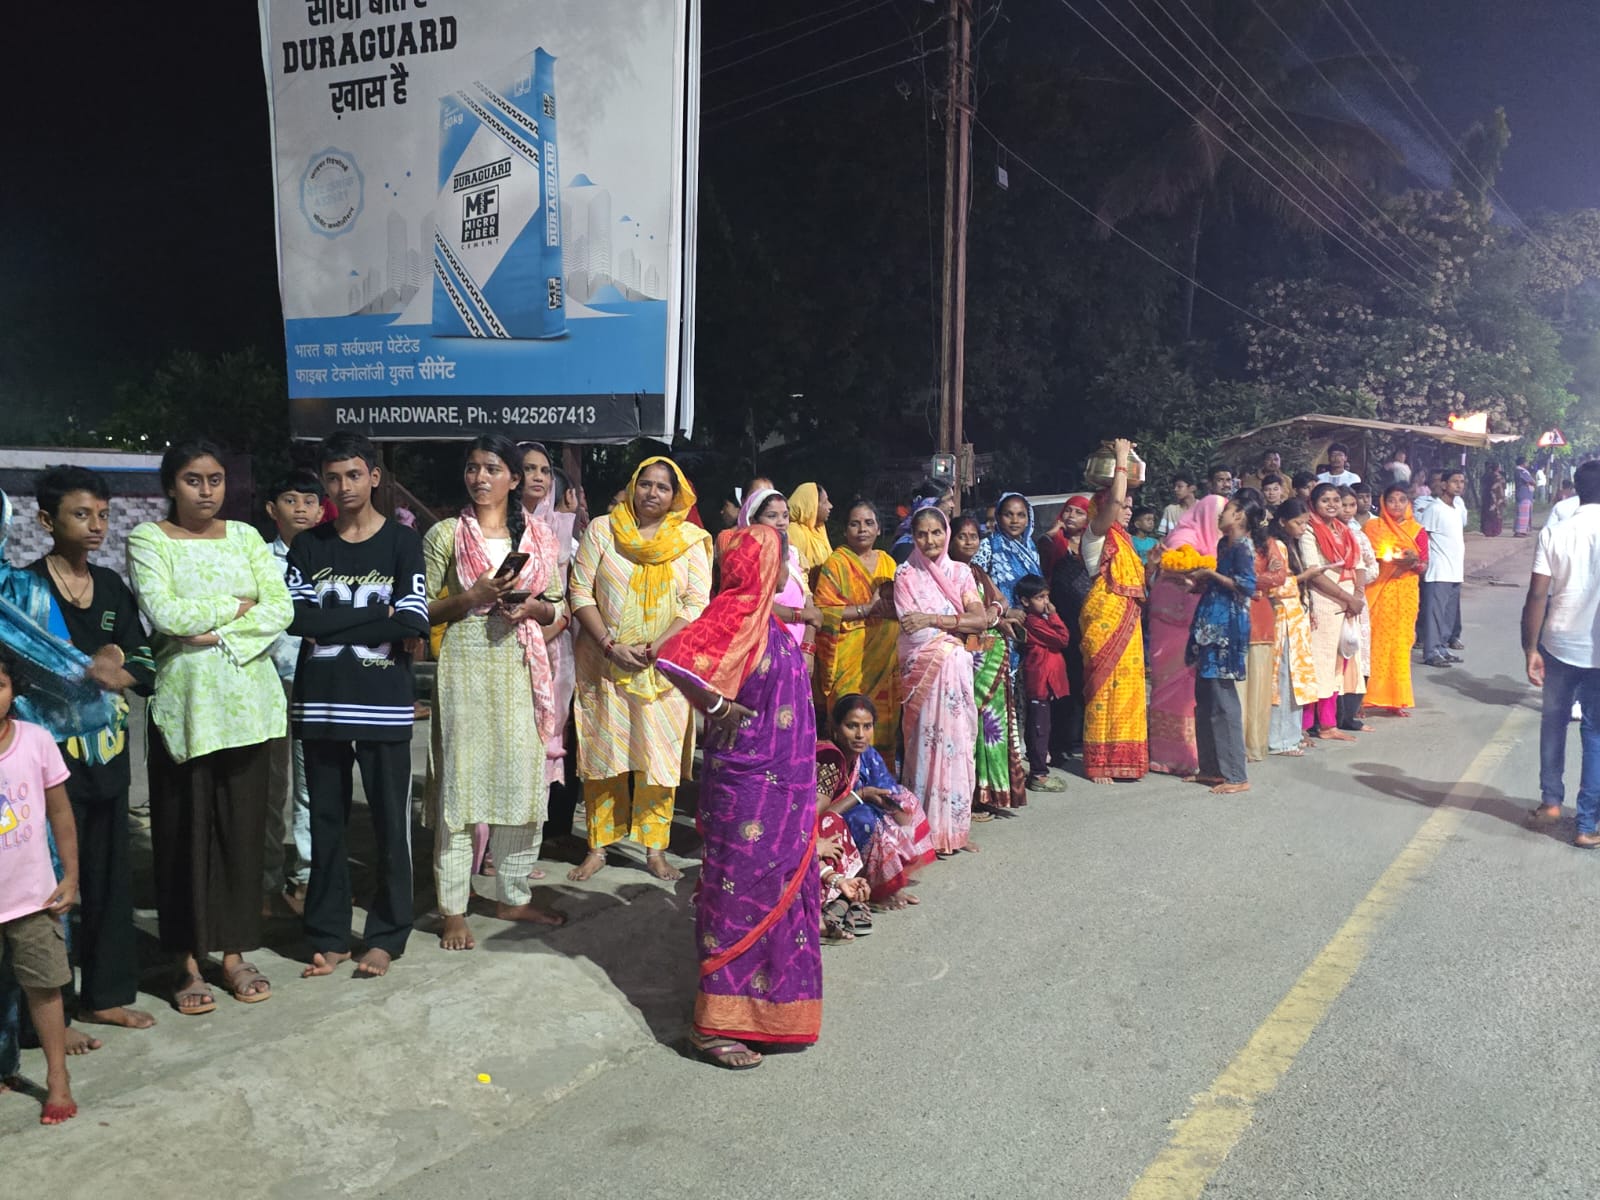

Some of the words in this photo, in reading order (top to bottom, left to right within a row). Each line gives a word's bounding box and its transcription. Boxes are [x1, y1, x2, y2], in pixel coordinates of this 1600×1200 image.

[282, 16, 457, 73] DURAGUARD
[391, 62, 409, 104] है
[453, 161, 511, 190] DURAGUARD
[465, 189, 496, 218] MF
[464, 215, 496, 231] MICRO
[464, 226, 496, 241] FIBER
[461, 239, 499, 250] CEMENT
[295, 344, 320, 357] भारत
[323, 343, 338, 356] का
[341, 337, 383, 356] सर्वप्रथम
[295, 369, 328, 384] फाइबर
[331, 361, 384, 381] टेक्नोलॉजी
[388, 365, 415, 386] युक्त
[418, 355, 457, 379] सीमेंट
[336, 407, 365, 424] RAJ
[369, 406, 463, 426] HARDWARE,
[501, 406, 597, 424] 9425267413
[412, 573, 426, 597] 6
